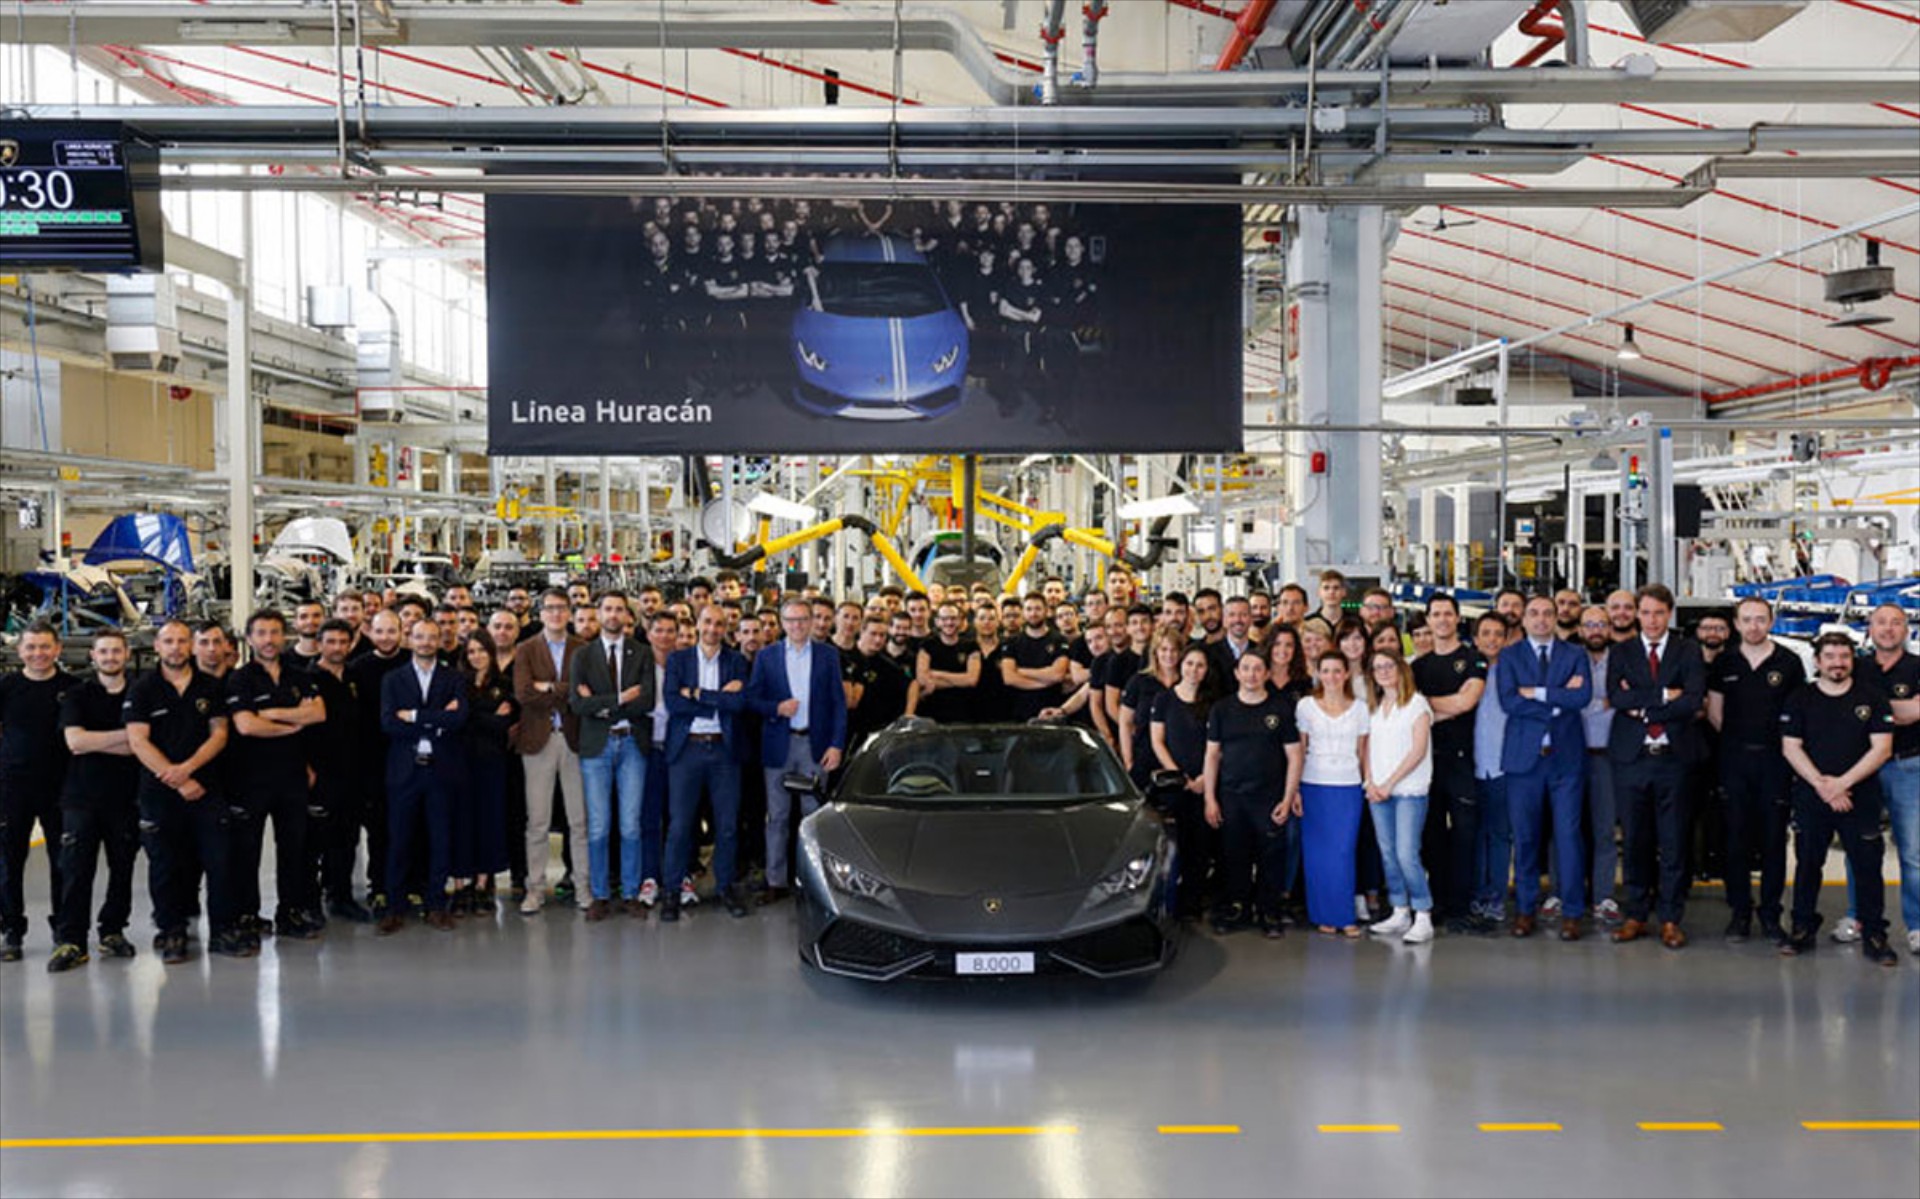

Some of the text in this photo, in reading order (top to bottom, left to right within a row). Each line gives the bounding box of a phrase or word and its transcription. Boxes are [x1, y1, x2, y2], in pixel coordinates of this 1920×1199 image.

[0, 170, 74, 209] :30
[511, 398, 712, 423] Linea Huracán
[973, 957, 1021, 972] 8.000
